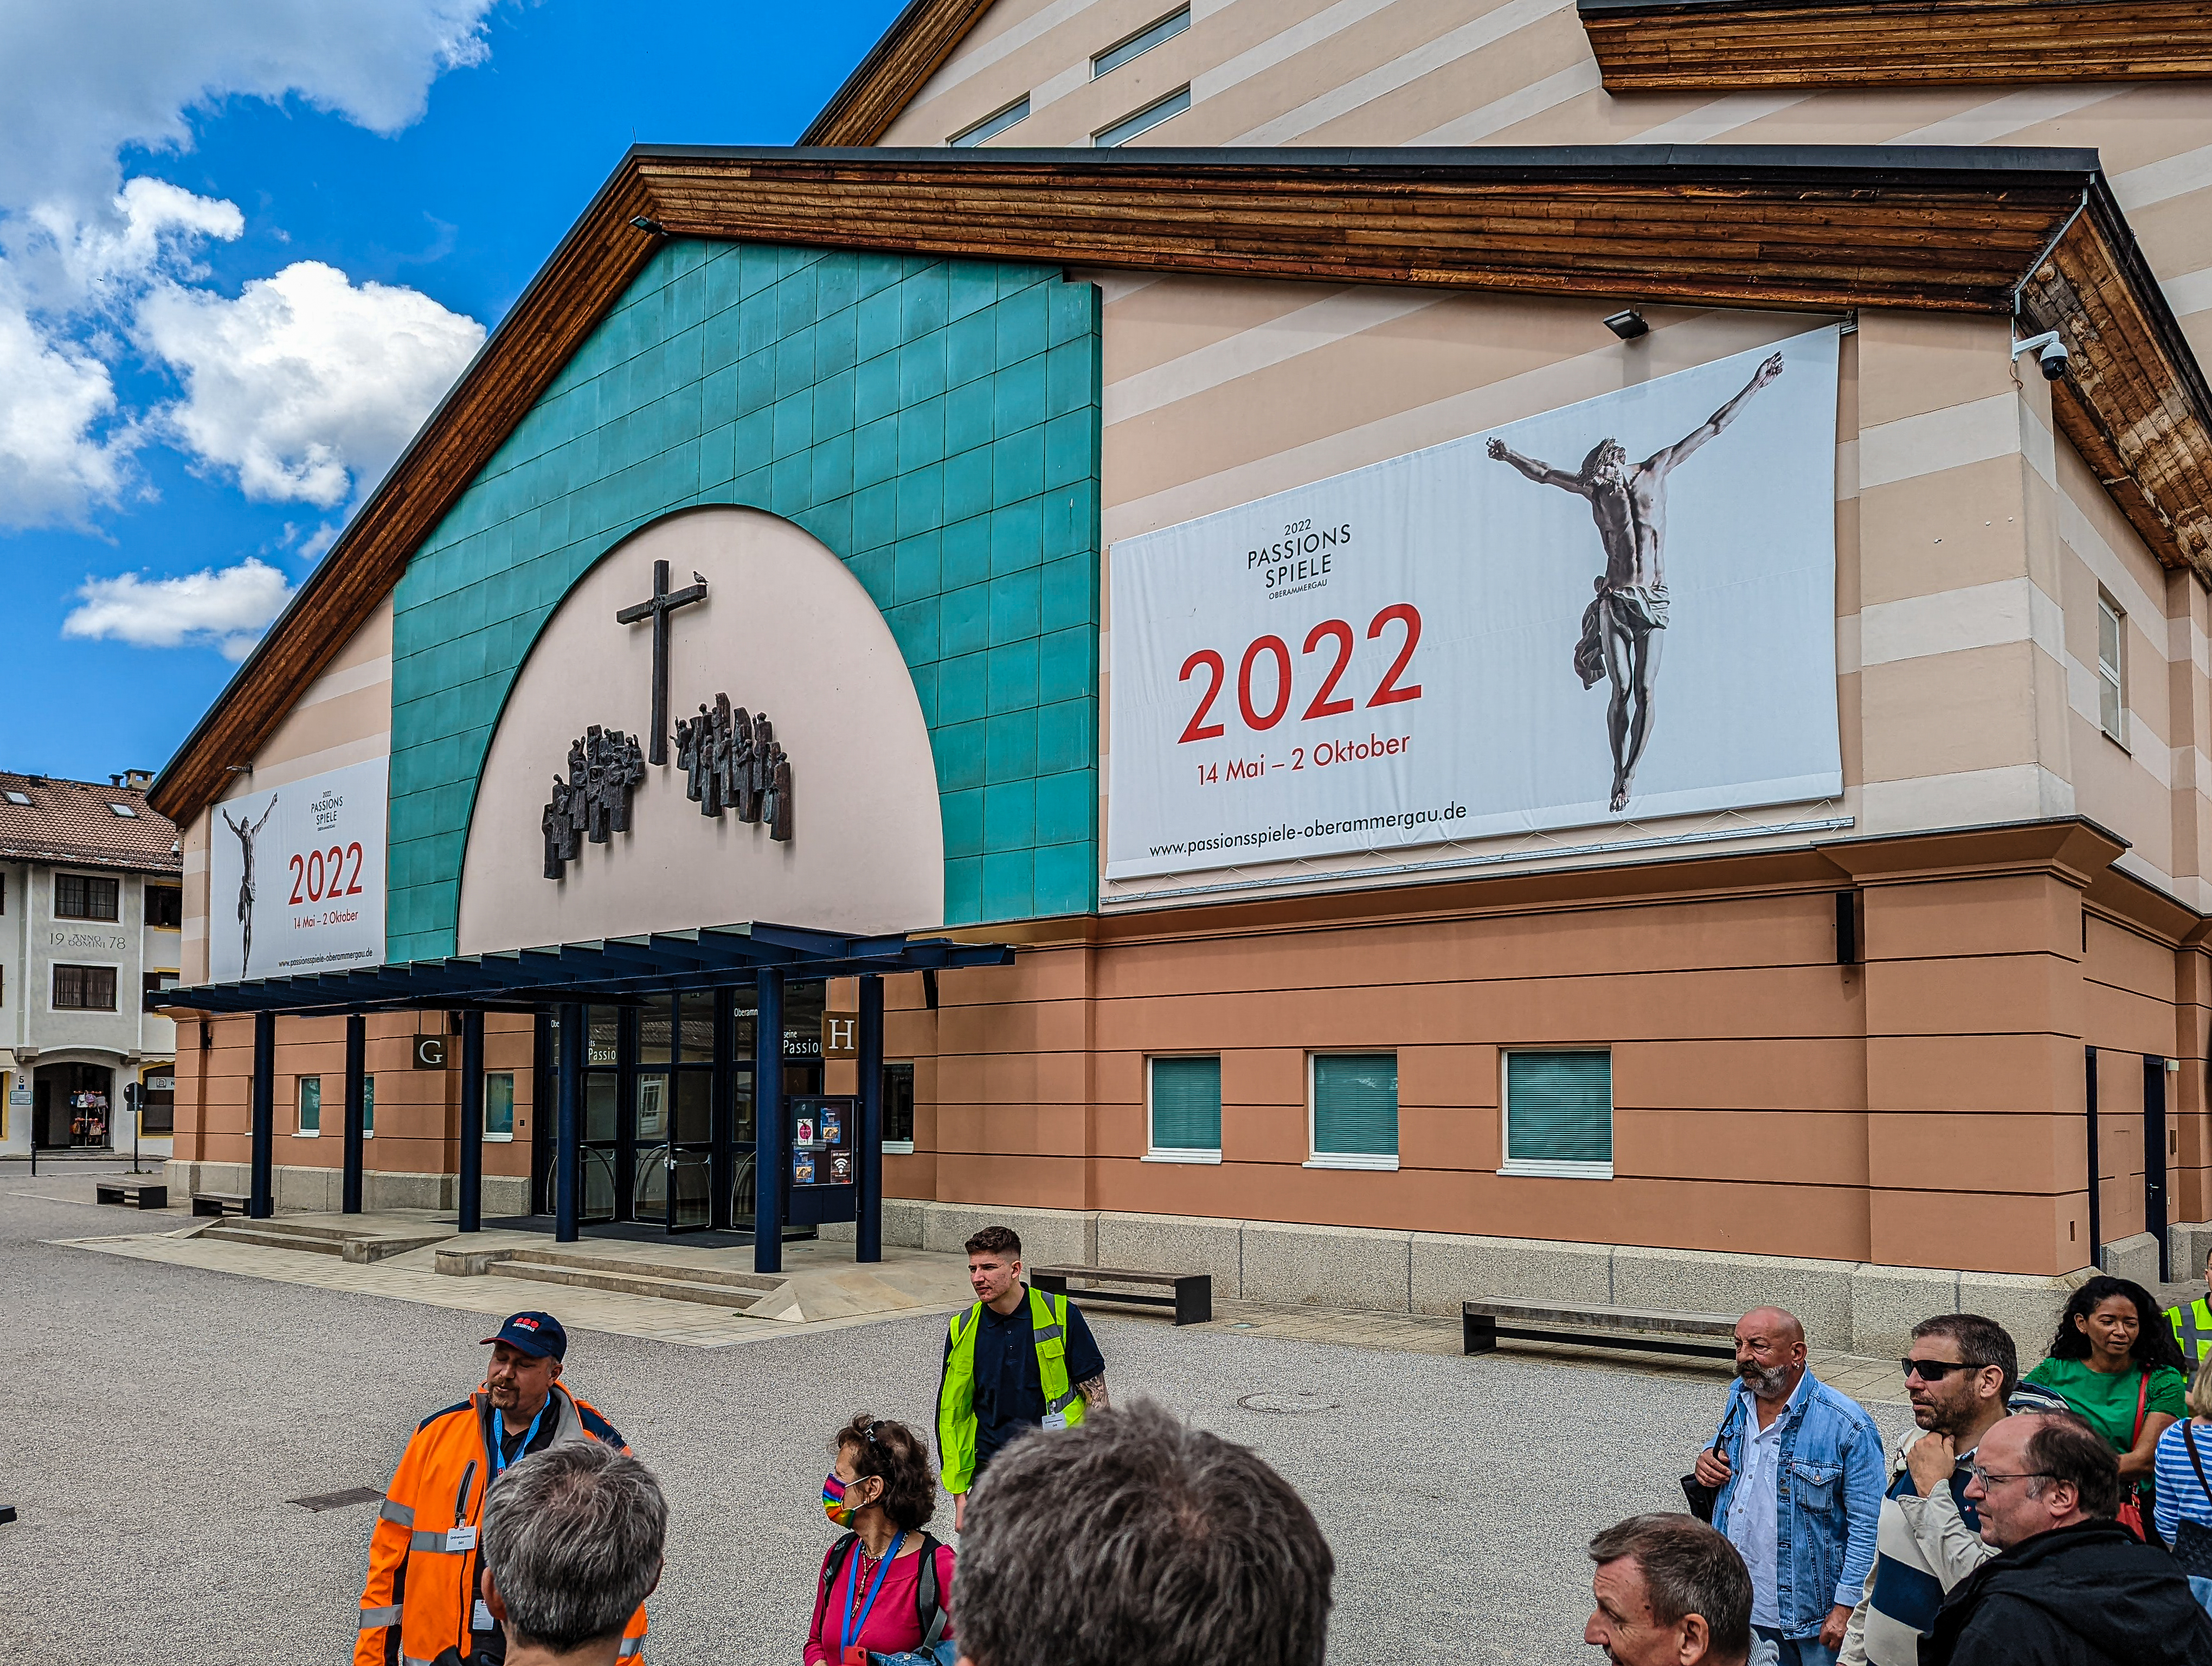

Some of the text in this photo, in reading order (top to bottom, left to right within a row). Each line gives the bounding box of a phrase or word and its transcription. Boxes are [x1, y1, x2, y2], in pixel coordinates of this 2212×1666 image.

[1284, 518, 1311, 536] 2022
[1248, 523, 1351, 570] PASSIONS
[1265, 553, 1332, 588] SPIELE
[1269, 578, 1328, 600] OBERAMMERGAU
[1176, 603, 1422, 745] 2022
[1197, 761, 1218, 786] 14
[1225, 753, 1264, 782] Mai
[1291, 747, 1304, 771] 2
[1313, 733, 1411, 766] Oktober
[311, 796, 343, 813] PASSIONS
[316, 810, 337, 825] SPIELE
[1149, 800, 1467, 857] www.passionsspiele-oberammergau.de
[288, 842, 362, 905] 2022
[294, 917, 301, 929] 14
[303, 914, 315, 928] Mai
[323, 912, 327, 925] 2
[329, 908, 358, 924] Oktober
[50, 933, 65, 945] 19
[68, 940, 105, 948] DOMINI
[73, 934, 101, 942] ANNO
[110, 937, 126, 949] 78
[783, 1029, 798, 1038] seine
[828, 1019, 855, 1049] H
[419, 1040, 443, 1063] G
[512, 1323, 536, 1332] SECURITAS
